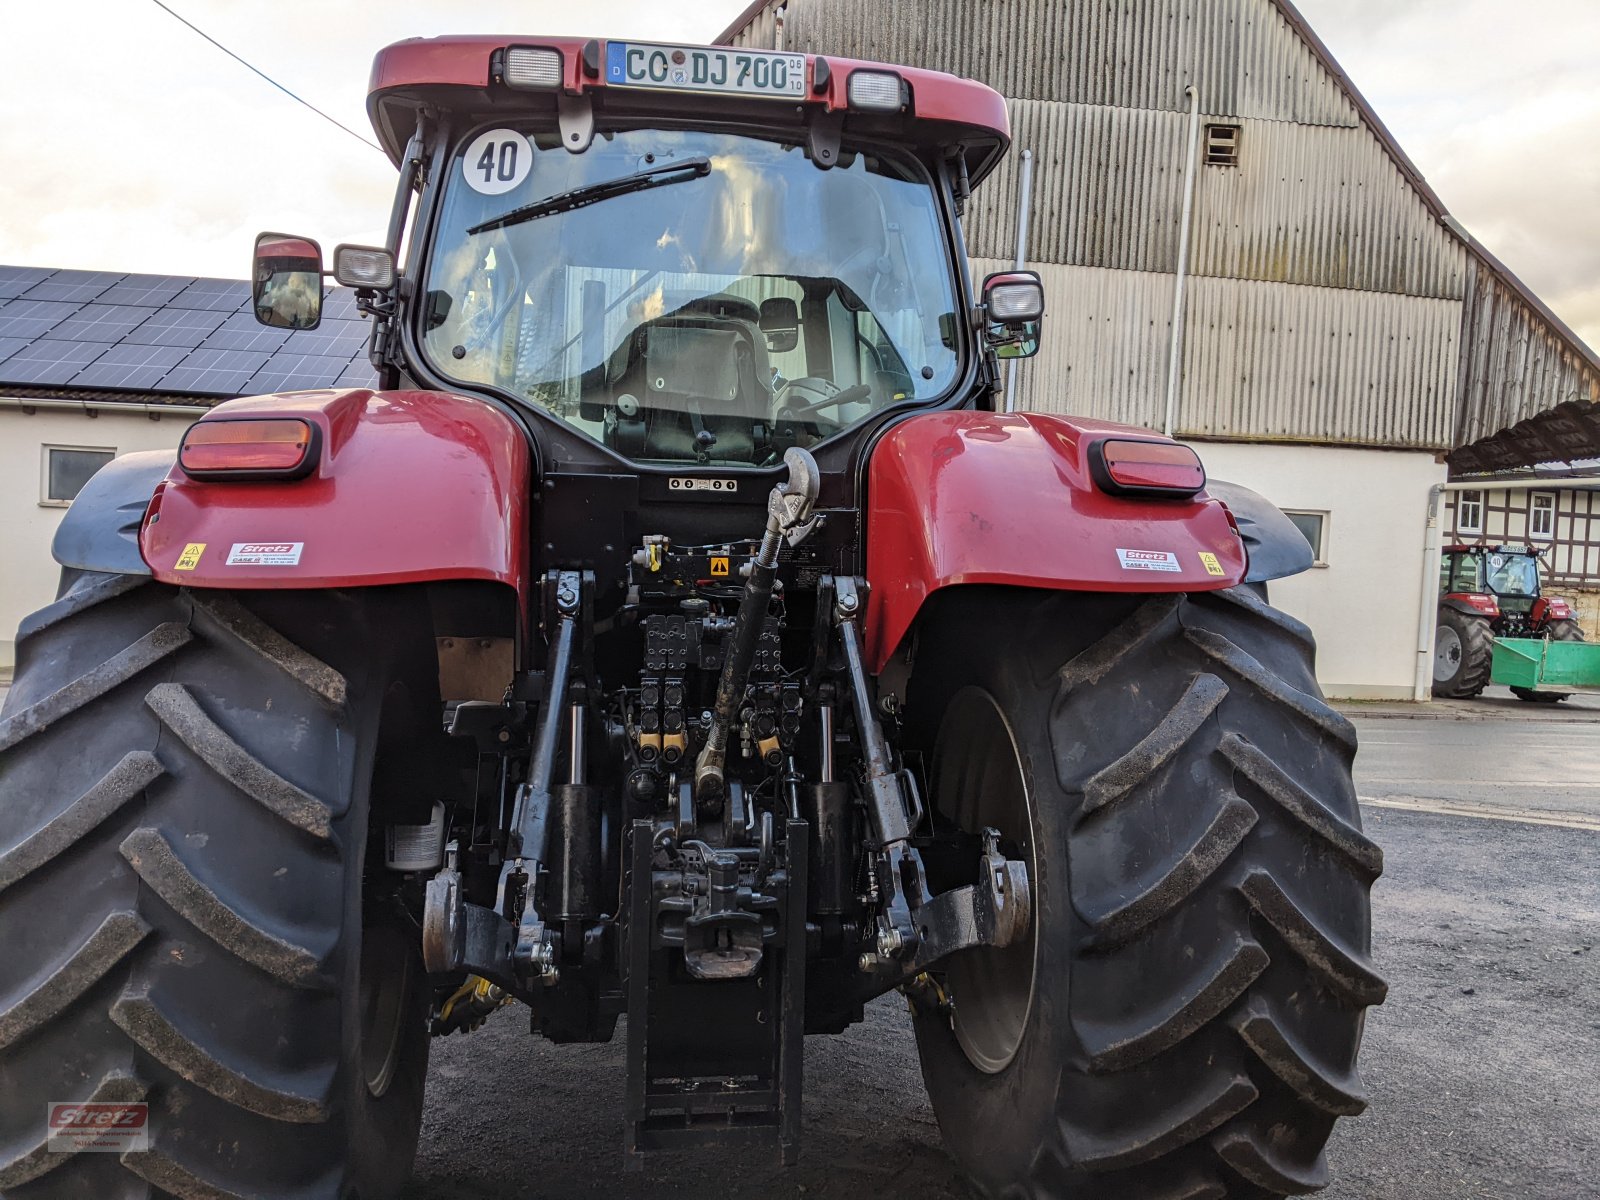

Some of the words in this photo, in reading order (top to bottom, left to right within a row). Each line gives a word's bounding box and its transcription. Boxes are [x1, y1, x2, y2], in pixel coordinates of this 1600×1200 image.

[612, 66, 620, 76] D
[626, 48, 668, 82] CO
[691, 52, 727, 86] DJ
[736, 55, 787, 89] 700
[790, 80, 802, 90] 10
[476, 140, 518, 183] 40
[1127, 551, 1165, 560] Stretz
[1492, 557, 1500, 566] 40
